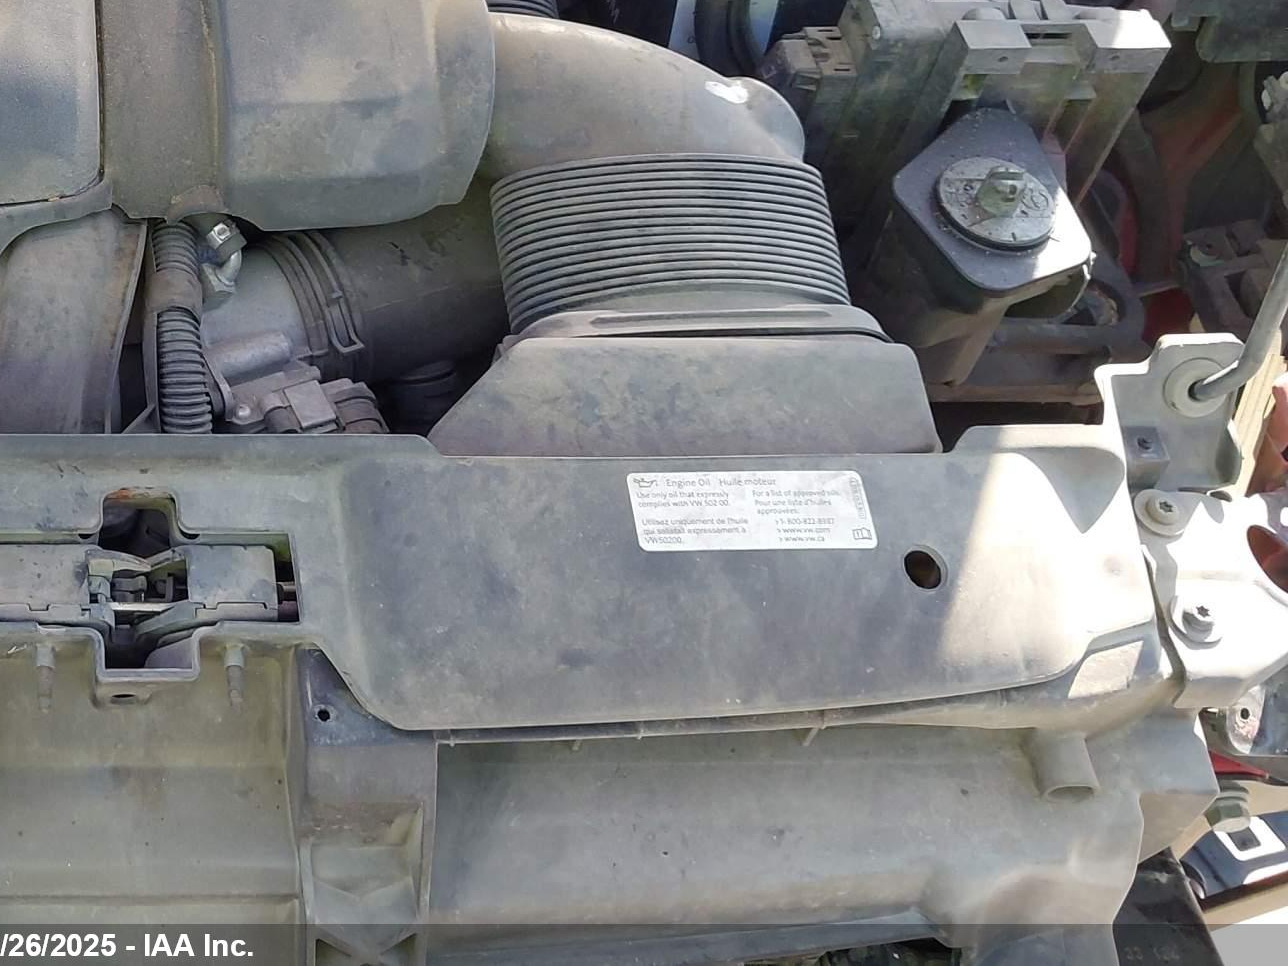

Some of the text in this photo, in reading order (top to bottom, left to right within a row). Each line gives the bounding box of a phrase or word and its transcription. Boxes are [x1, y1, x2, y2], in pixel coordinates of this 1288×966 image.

[665, 478, 776, 489] Engine Oil Huile moteur
[652, 491, 667, 499] only
